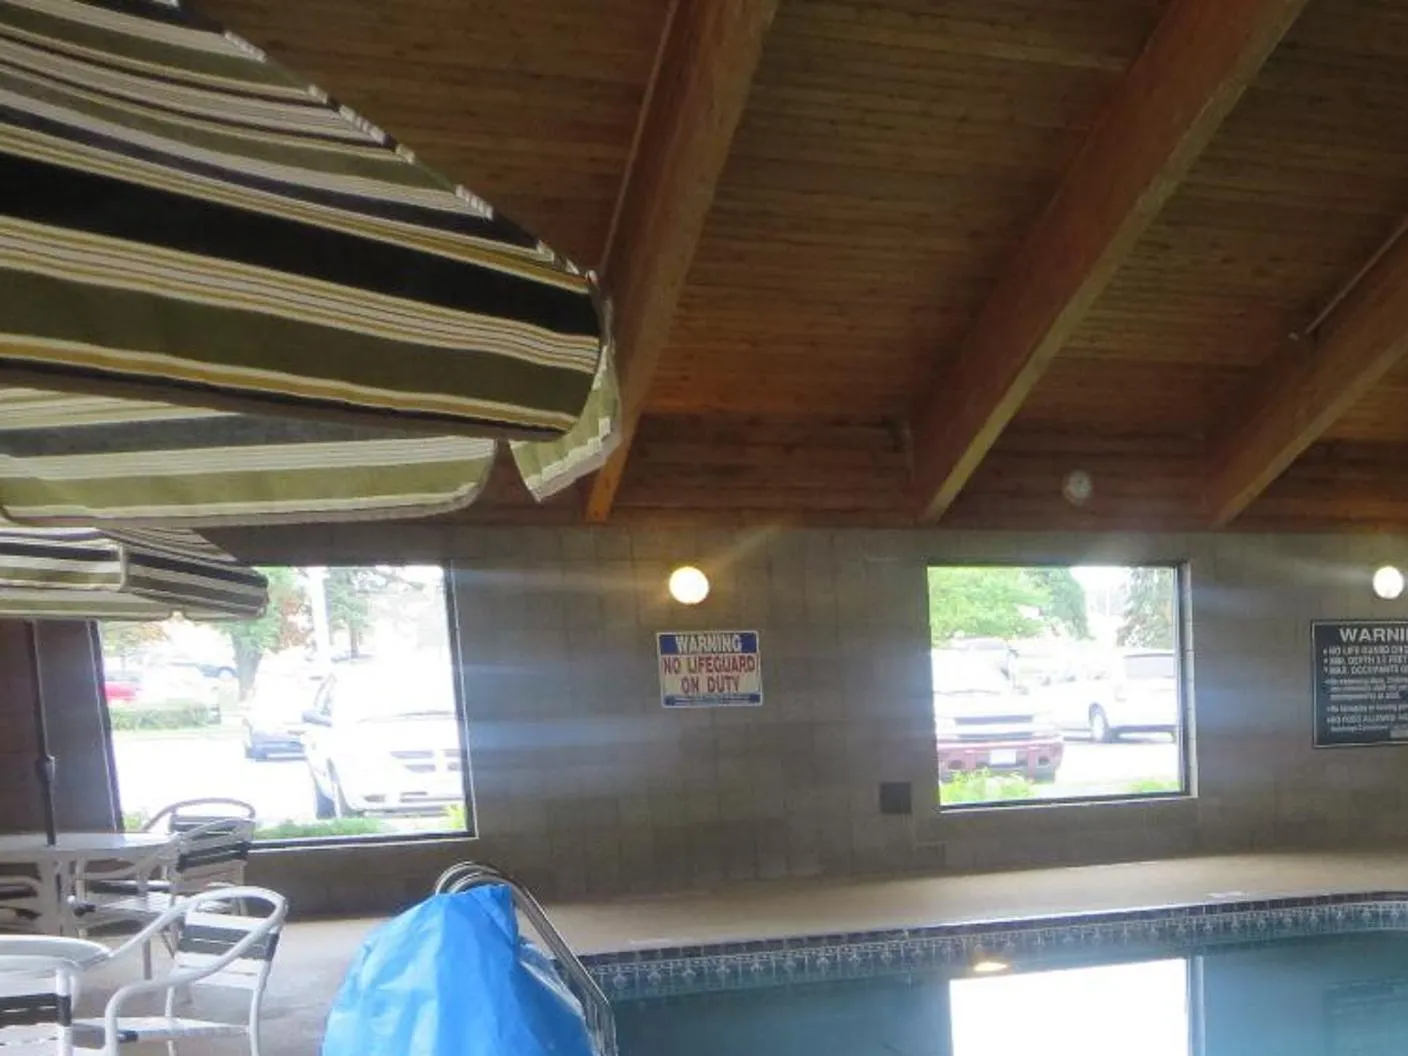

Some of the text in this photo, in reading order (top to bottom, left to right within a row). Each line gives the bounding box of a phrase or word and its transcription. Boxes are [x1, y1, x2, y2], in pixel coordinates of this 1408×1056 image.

[676, 633, 743, 653] WARNING
[663, 655, 757, 675] NO LIFEGUARD
[681, 676, 740, 693] ON DUTY
